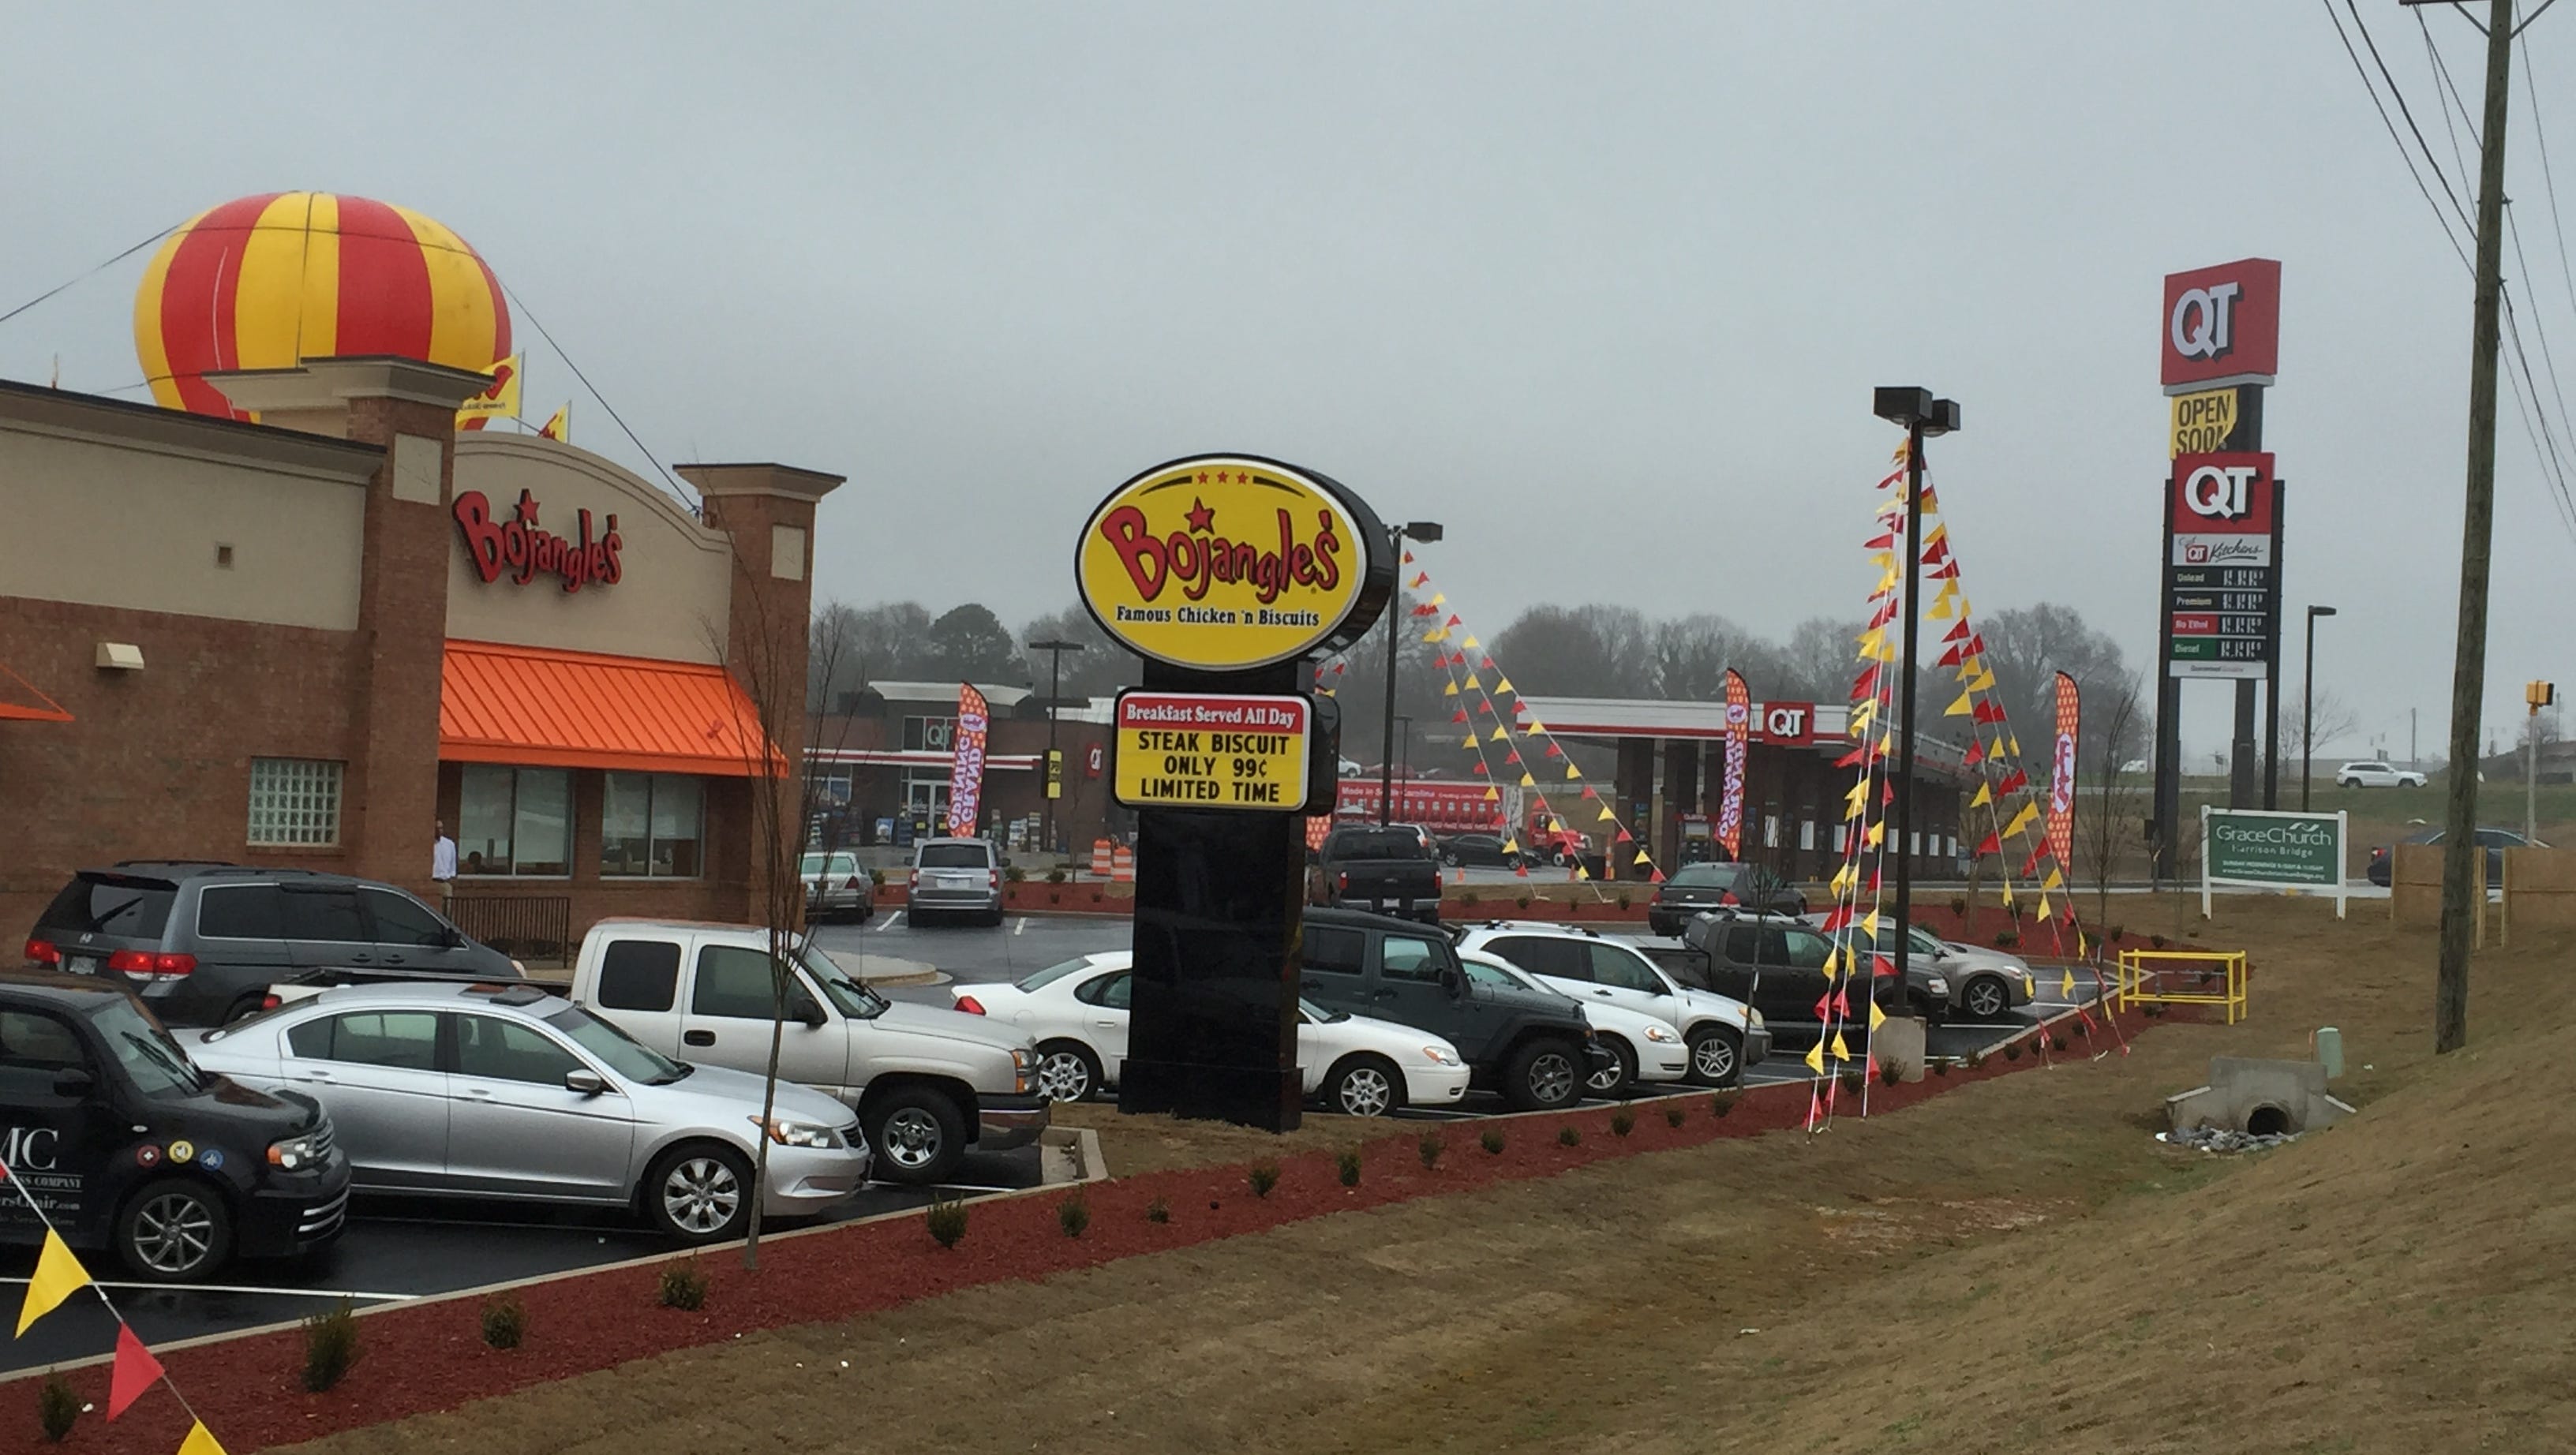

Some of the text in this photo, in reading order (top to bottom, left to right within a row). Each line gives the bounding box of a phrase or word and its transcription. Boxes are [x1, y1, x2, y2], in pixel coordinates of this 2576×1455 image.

[2171, 282, 2238, 357] QT
[2178, 395, 2230, 427] OPEN
[2185, 466, 2256, 518] QT
[2187, 548, 2205, 561] QT
[2176, 596, 2212, 606] Premium
[1117, 605, 1171, 623] Famous
[1177, 607, 1236, 624] Chicken
[1258, 609, 1320, 627] Biscuits
[2174, 643, 2200, 654] Diesel
[1126, 703, 1296, 728] Breakfast Served All Day
[1769, 709, 1805, 738] QT
[927, 724, 953, 746] QT
[1138, 731, 1290, 755] STEAK BISCUIT
[1164, 755, 1267, 778] ONLY 99¢
[1140, 778, 1279, 802] LIMITED TIME
[2232, 845, 2313, 858] Harrison Bridge
[34, 1176, 80, 1188] COMPANY
